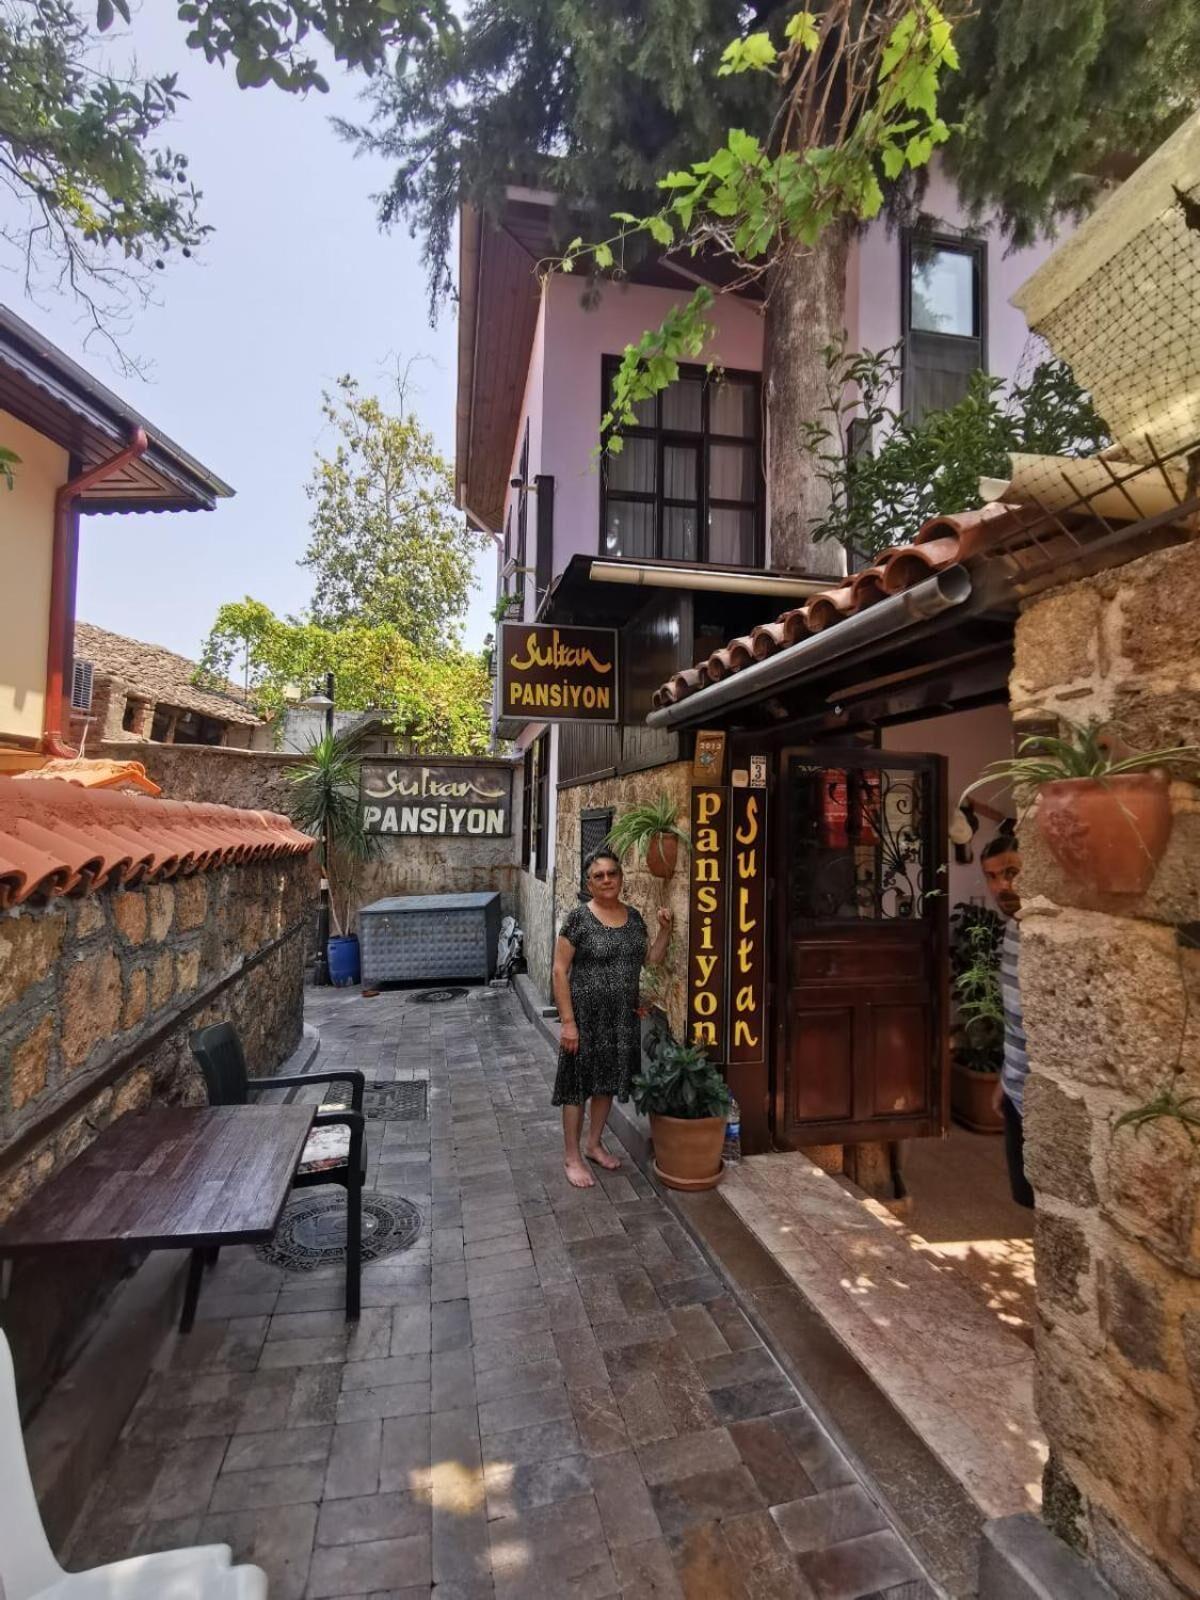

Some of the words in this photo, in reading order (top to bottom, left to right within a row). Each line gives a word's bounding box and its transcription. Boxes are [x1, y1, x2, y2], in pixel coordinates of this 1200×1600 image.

[510, 629, 612, 673] Sultan
[510, 679, 610, 708] PANSİYON
[364, 768, 506, 799] Sultan
[754, 764, 762, 779] 3
[362, 803, 504, 834] PANSİYON
[692, 792, 721, 1046] pansiyon
[735, 795, 758, 1047] Sultan
